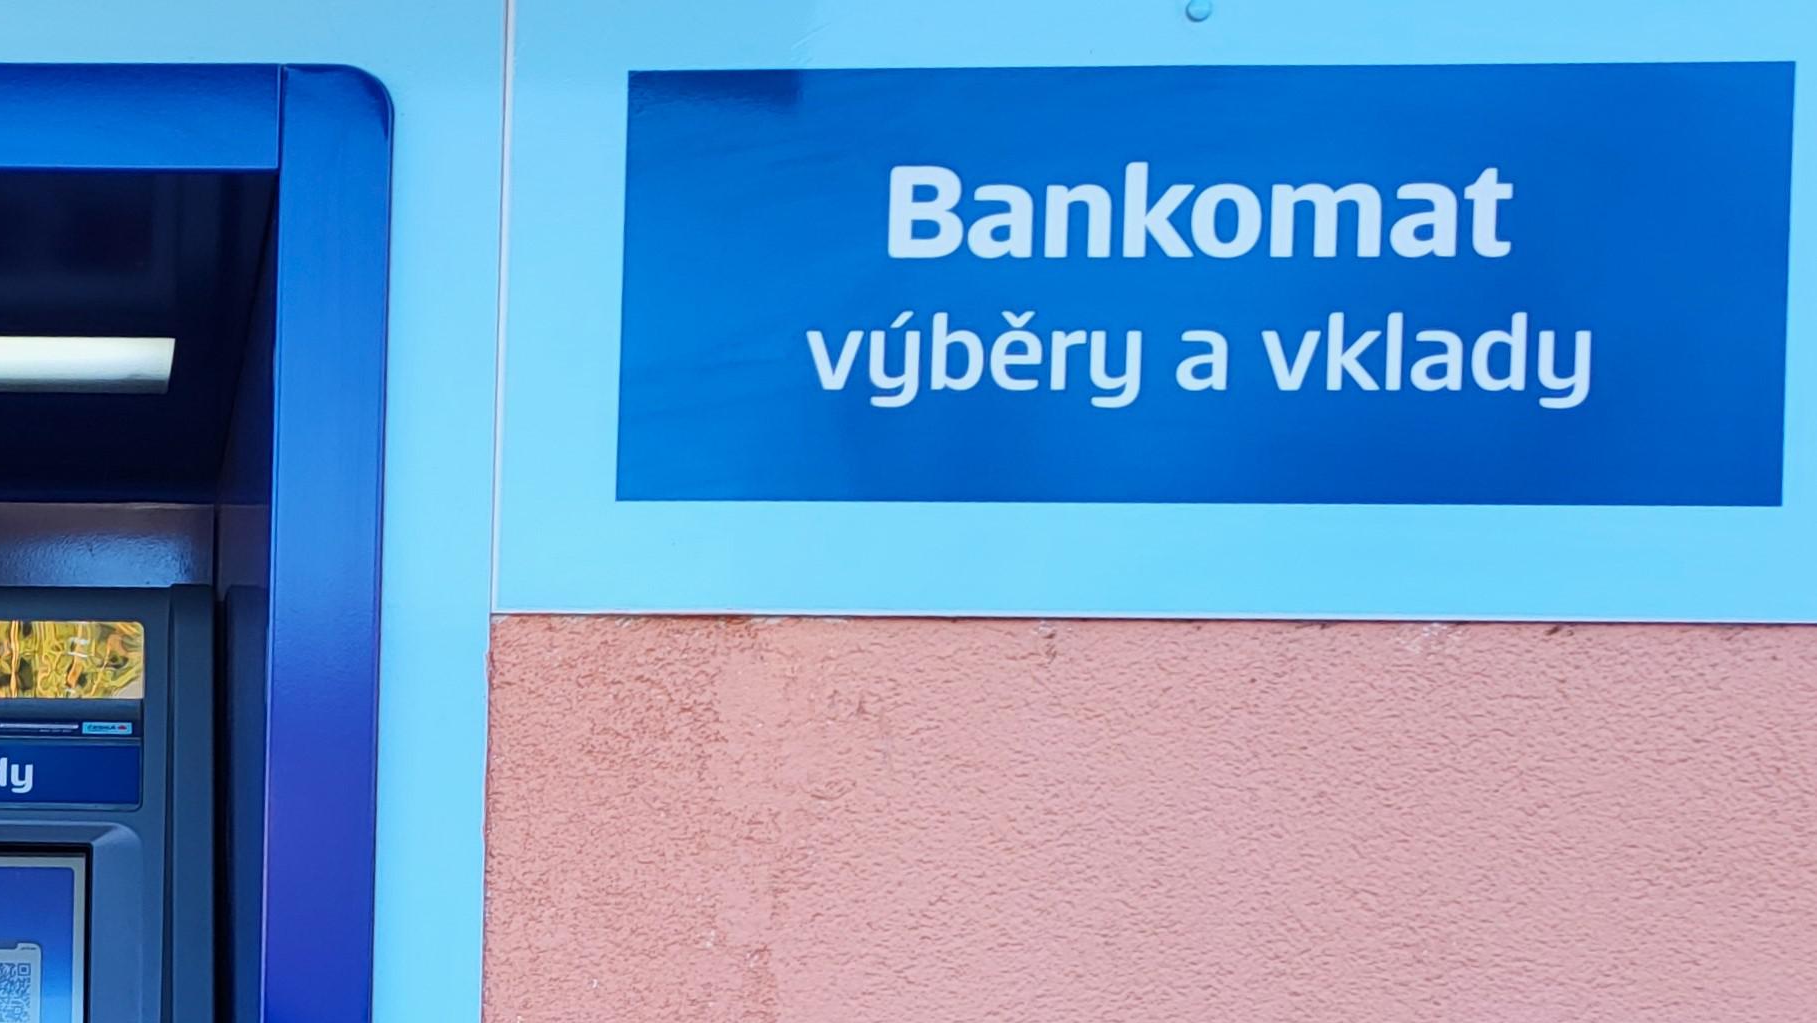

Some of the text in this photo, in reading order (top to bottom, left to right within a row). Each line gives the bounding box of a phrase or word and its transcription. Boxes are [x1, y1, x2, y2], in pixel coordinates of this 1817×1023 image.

[887, 161, 1515, 260] Bankomat
[806, 310, 1593, 409] výběry a vklady
